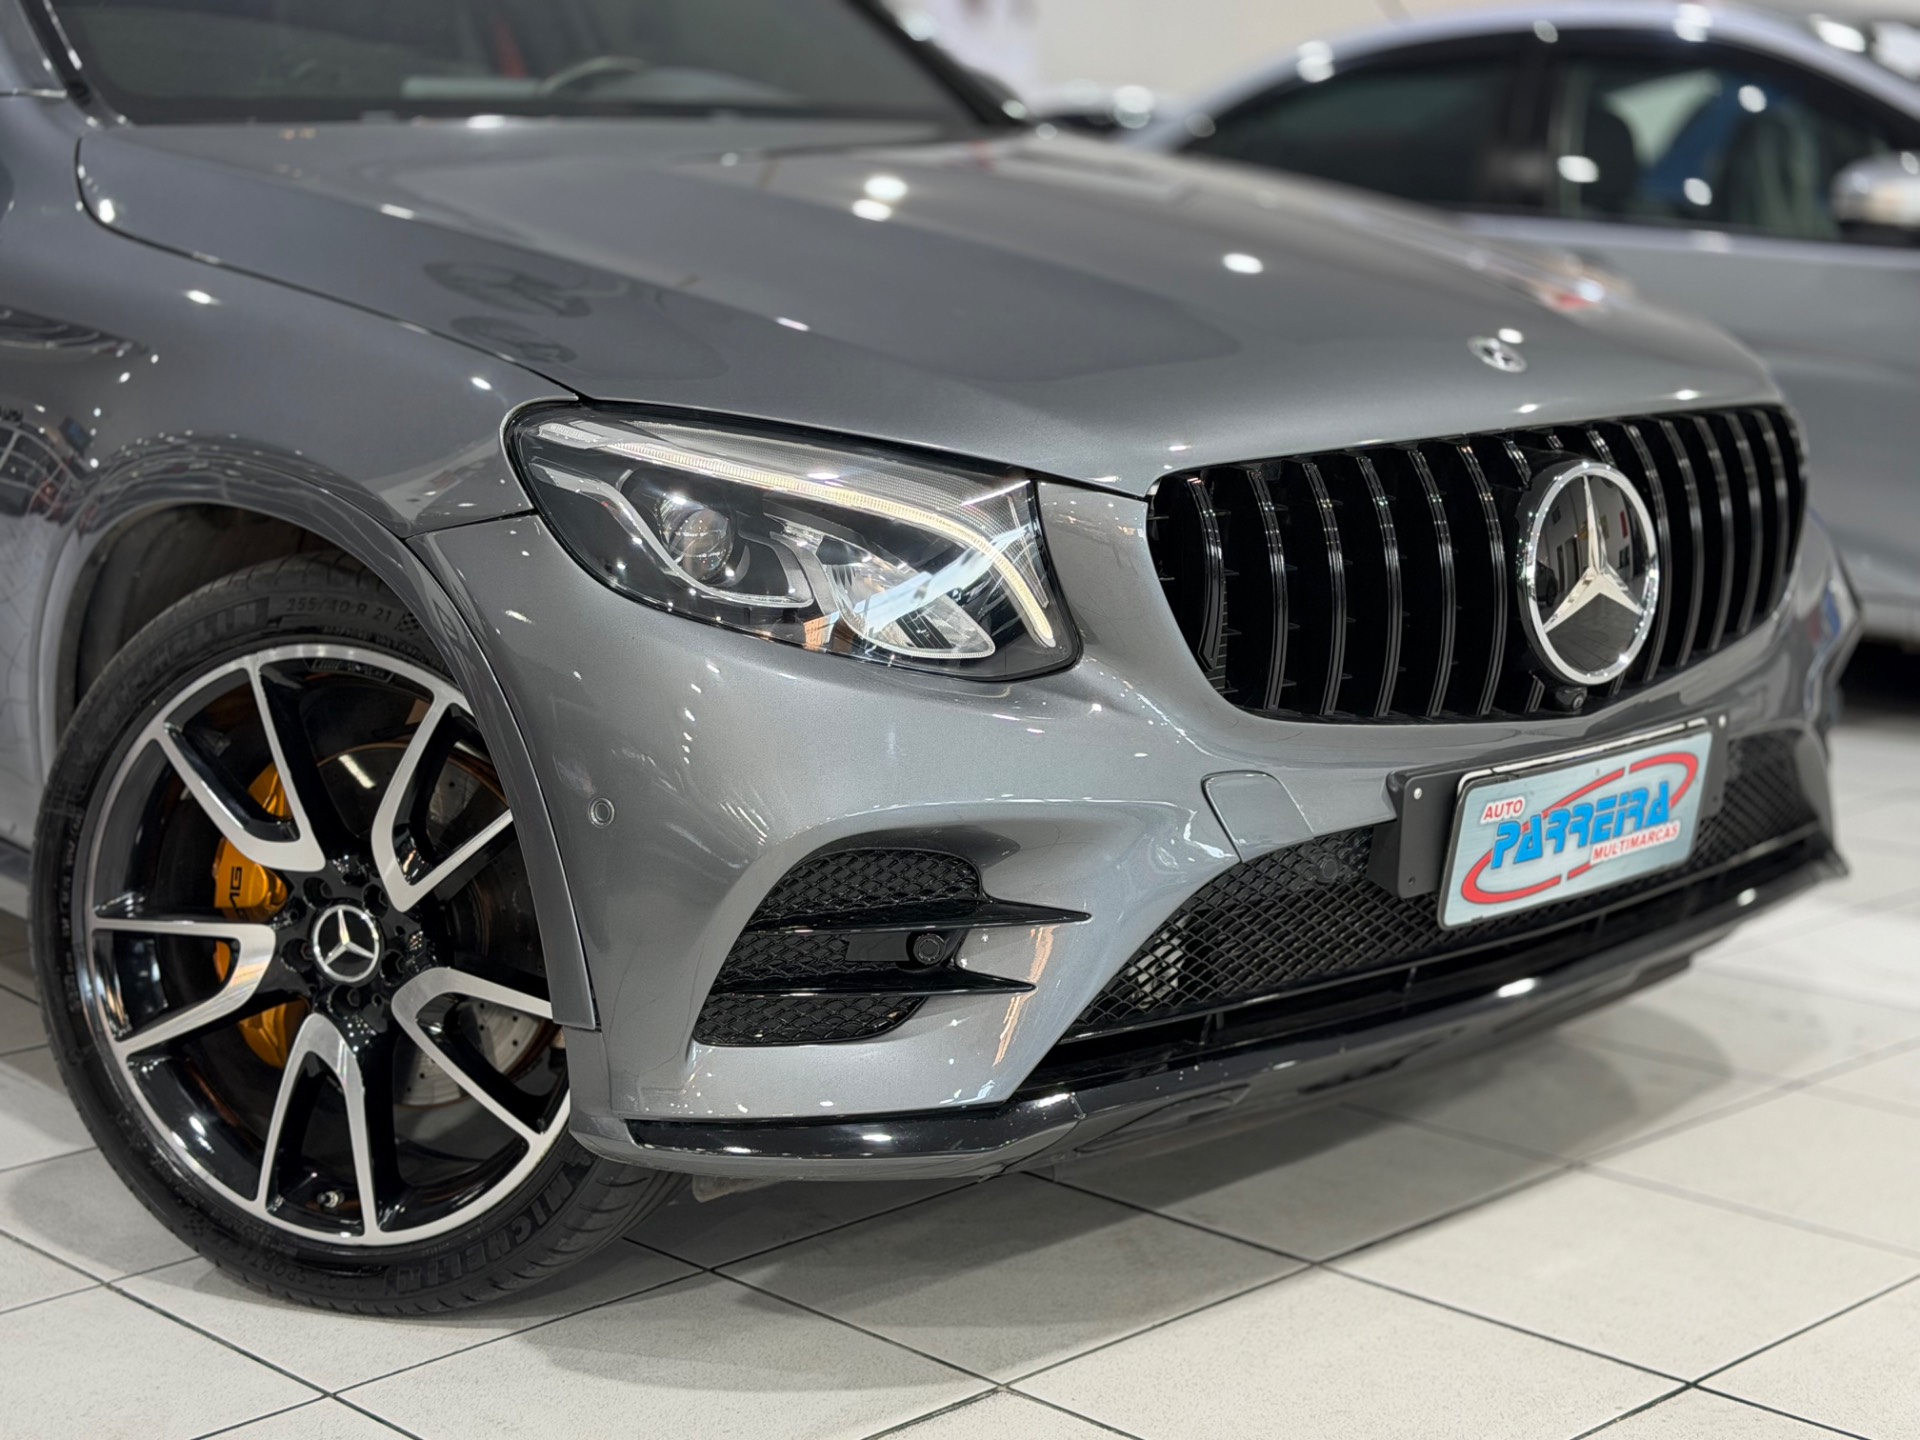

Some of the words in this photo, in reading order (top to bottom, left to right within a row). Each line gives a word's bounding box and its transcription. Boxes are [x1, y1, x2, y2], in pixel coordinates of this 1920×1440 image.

[372, 606, 393, 623] 21
[1483, 798, 1524, 820] AUTO
[1491, 780, 1670, 869] PARREIRA
[1592, 824, 1679, 860] MULTIMARCAS
[395, 1171, 575, 1294] MICHELIN
